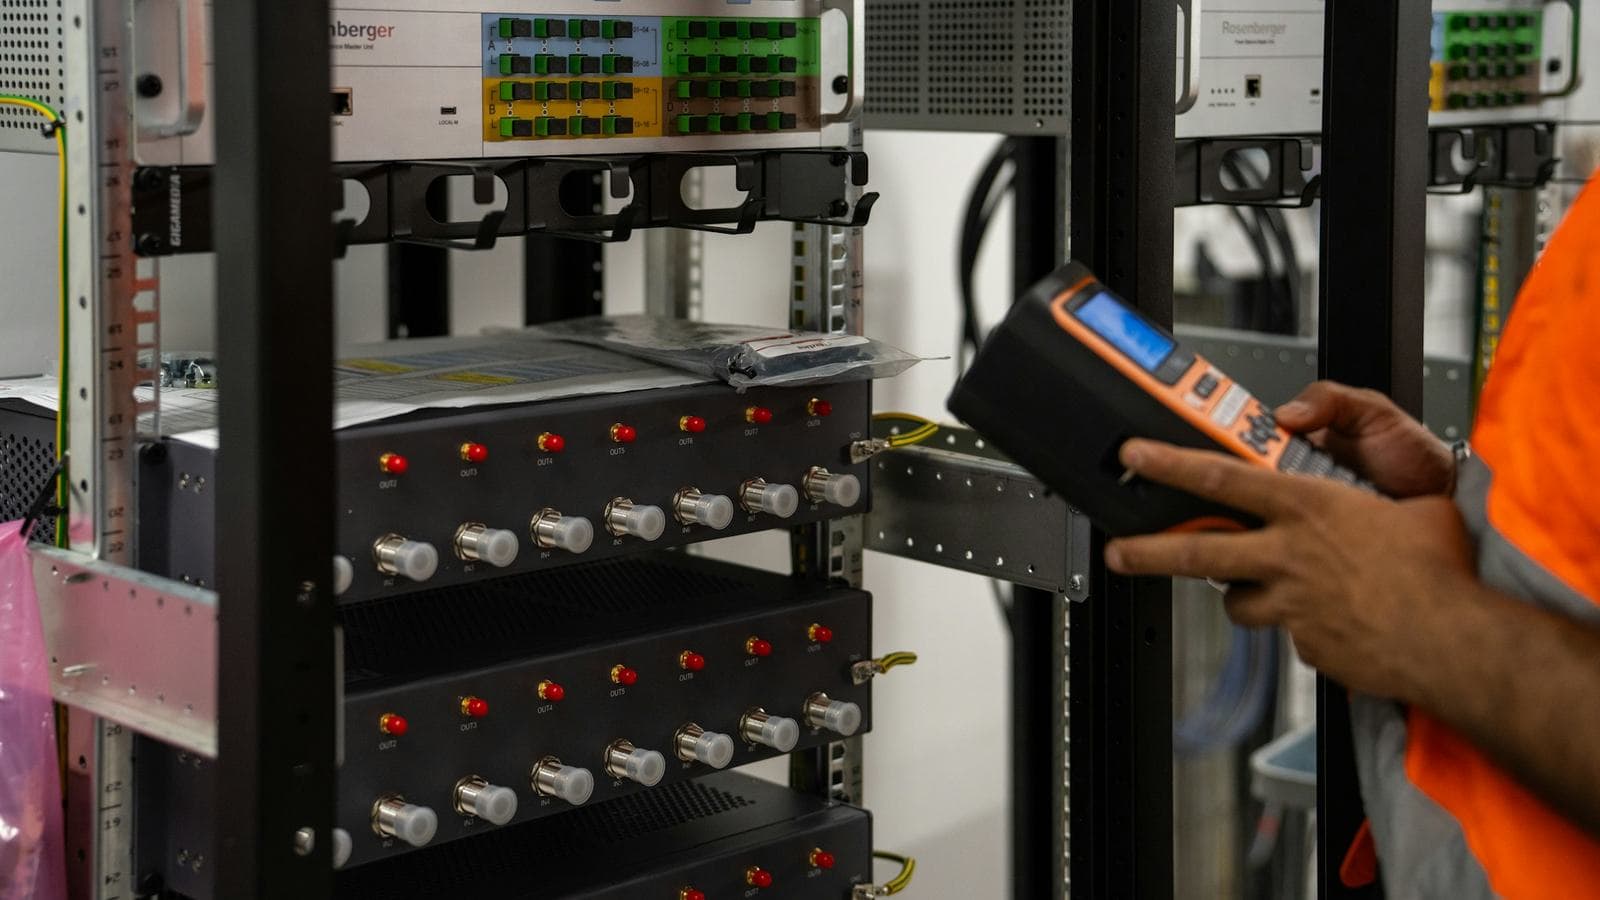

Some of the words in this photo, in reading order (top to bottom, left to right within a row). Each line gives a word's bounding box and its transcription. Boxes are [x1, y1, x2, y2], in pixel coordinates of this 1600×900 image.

[1222, 20, 1286, 37] Rosenberger
[488, 40, 495, 51] A
[666, 42, 673, 52] C
[489, 104, 496, 115] B
[609, 446, 625, 456] OUT5
[537, 457, 553, 467] OUT4
[609, 688, 625, 697] OUT5
[537, 704, 553, 714] OUT4
[460, 721, 478, 732] OUT3
[379, 740, 397, 750] OUT2
